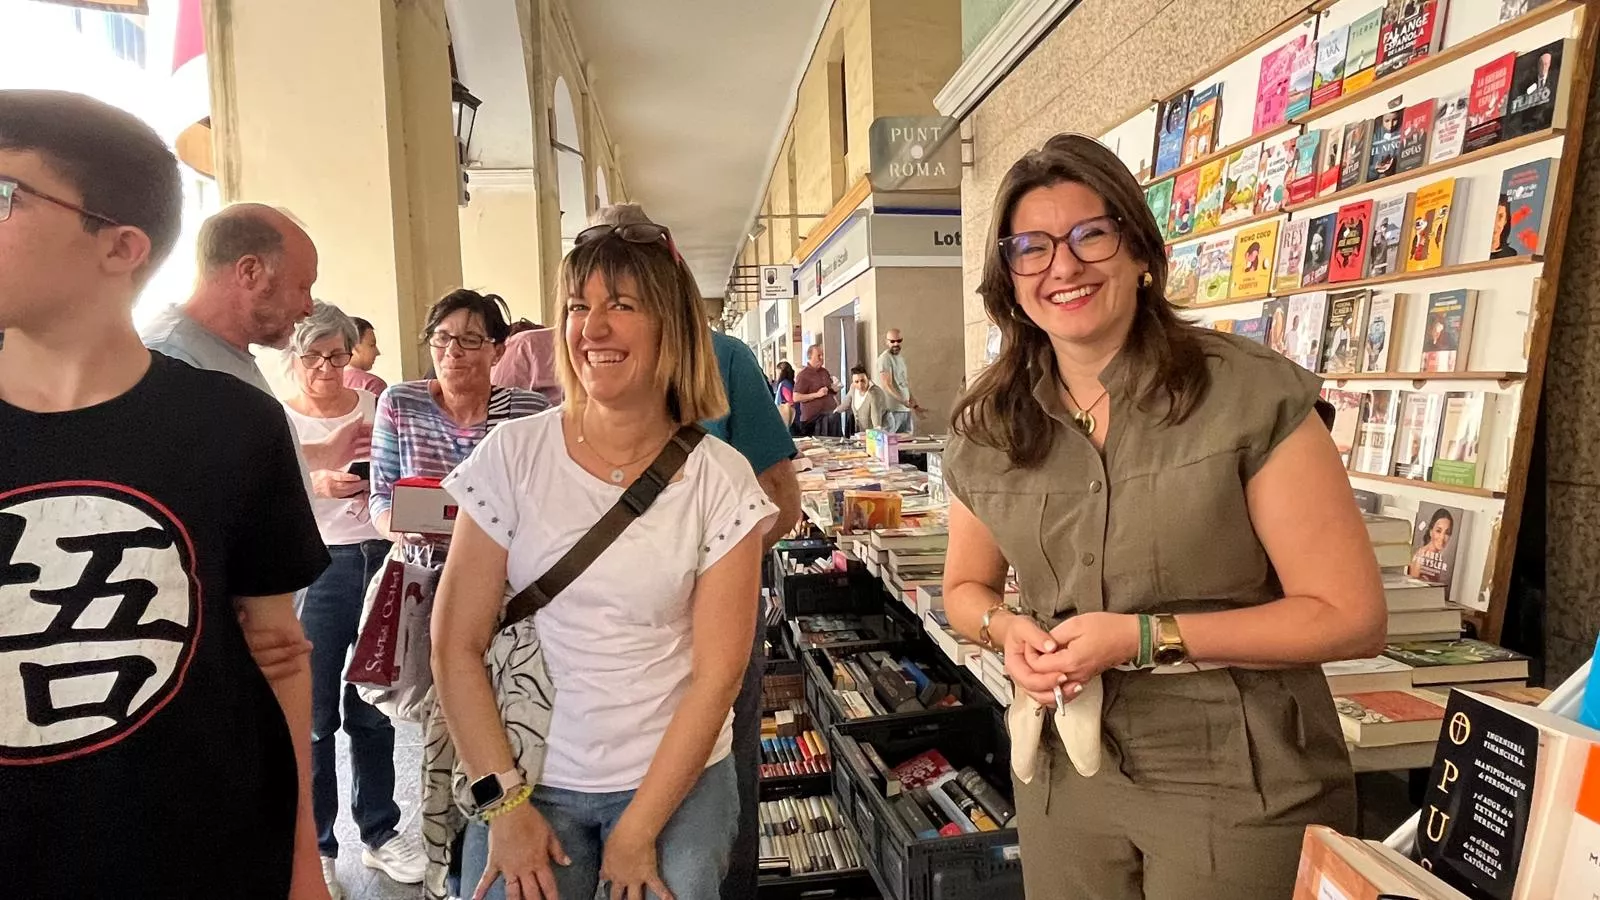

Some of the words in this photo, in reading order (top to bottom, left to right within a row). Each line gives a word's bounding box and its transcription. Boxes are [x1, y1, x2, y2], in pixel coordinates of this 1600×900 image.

[1352, 19, 1378, 39] TIERRA
[1383, 12, 1430, 44] FALANGE
[891, 127, 942, 142] PUNT
[889, 162, 946, 177] ROMA
[1486, 731, 1525, 756] INGENIERÍA
[1474, 759, 1526, 791] MANIPULACIÓN
[1484, 775, 1518, 797] PERSONAS
[1483, 796, 1501, 811] AUGE
[1473, 813, 1506, 838] DERECHA
[1475, 803, 1508, 828] EXTREMA
[1480, 840, 1500, 857] SENO
[1463, 853, 1497, 879] CATÓLICA
[1475, 849, 1502, 871] IGLESIA
